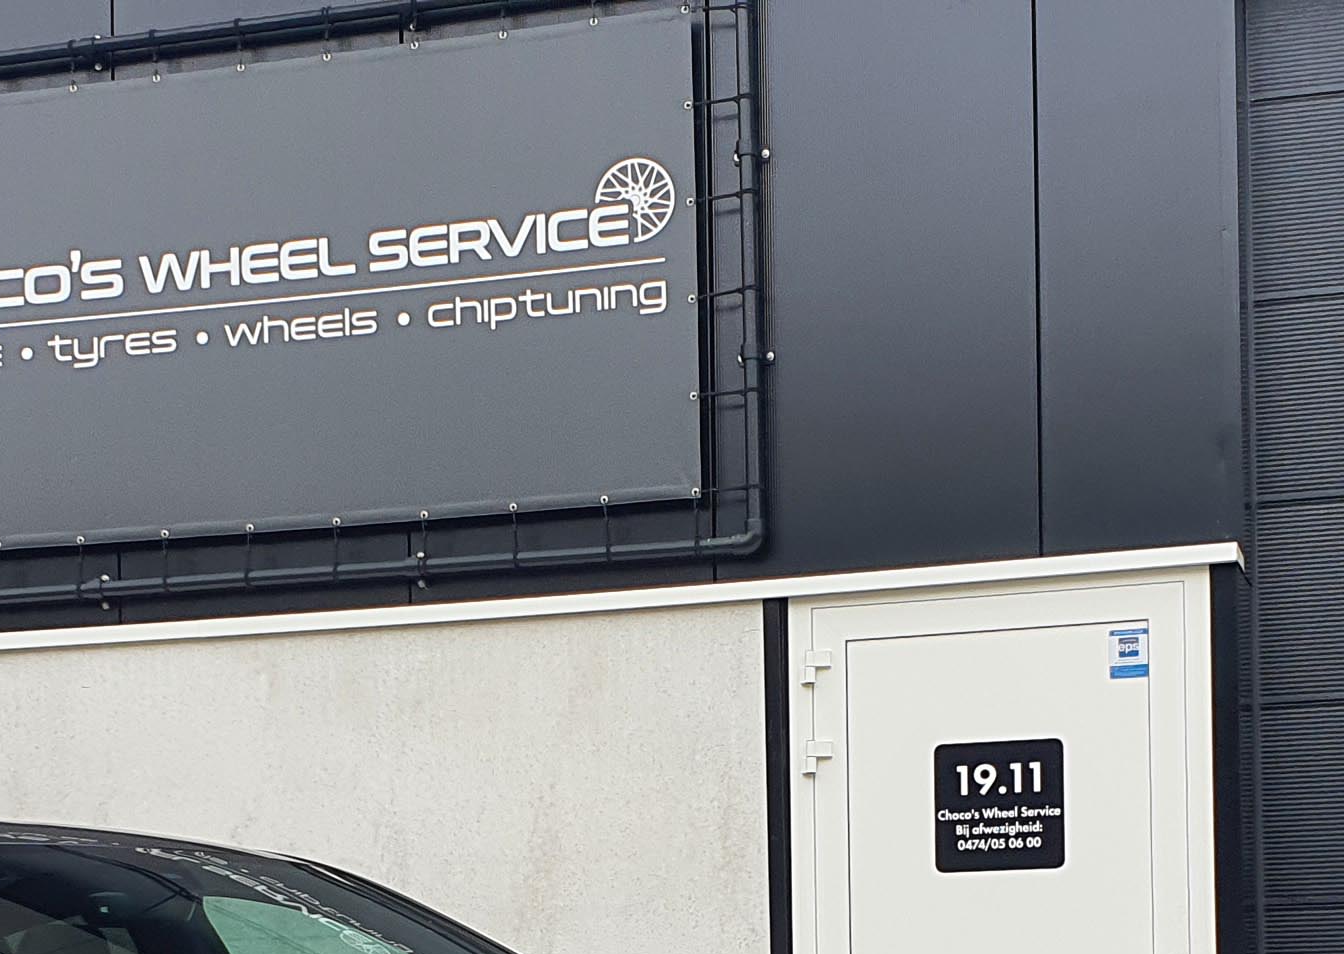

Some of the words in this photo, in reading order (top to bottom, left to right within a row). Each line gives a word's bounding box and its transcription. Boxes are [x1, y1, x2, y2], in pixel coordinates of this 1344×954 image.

[138, 237, 357, 294] WHEEL
[368, 203, 631, 273] SERVICE
[46, 331, 177, 369] tyres
[223, 307, 378, 347] wheels
[427, 279, 667, 331] chiptuning
[955, 761, 1043, 797] 19.11
[938, 807, 981, 822] Choco's
[981, 805, 1019, 820] Wheel
[1020, 804, 1061, 818] Service
[955, 824, 970, 839] Bij
[971, 821, 1044, 838] afwezigheid:
[957, 837, 1006, 852] 0474/05
[1008, 837, 1024, 850] 06
[1025, 836, 1042, 849] 00
